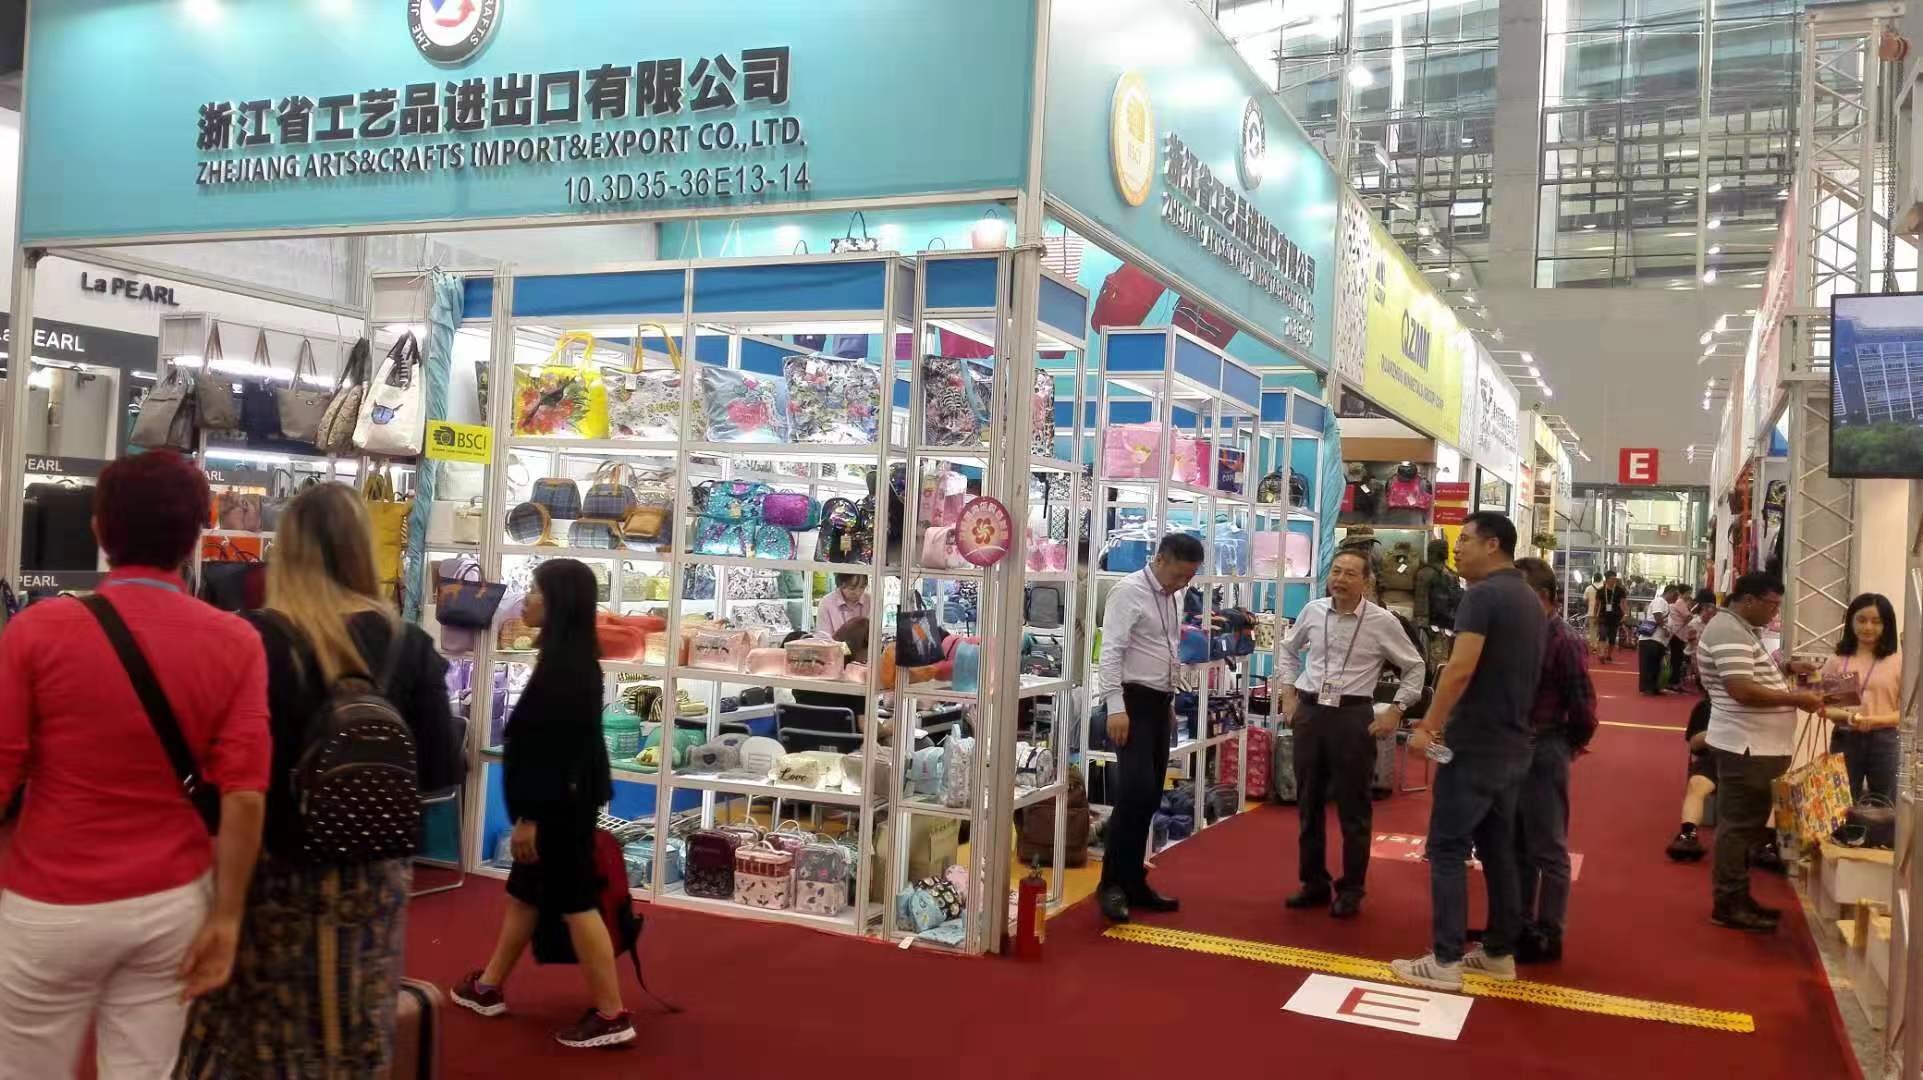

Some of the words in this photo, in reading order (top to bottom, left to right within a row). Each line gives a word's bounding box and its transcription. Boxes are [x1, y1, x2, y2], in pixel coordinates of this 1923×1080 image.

[197, 46, 790, 149] 浙江省工艺品进出口有限公司
[196, 155, 299, 185] ZHEJIANG
[304, 143, 463, 178] ARTS&CRAFTS
[470, 125, 690, 168] IMPORT&EXPORT
[81, 272, 107, 293] La
[112, 276, 179, 306] PEARL
[34, 329, 85, 352] EARL
[457, 433, 486, 449] BSCI
[1630, 453, 1649, 479] E
[1337, 987, 1430, 1026] E
